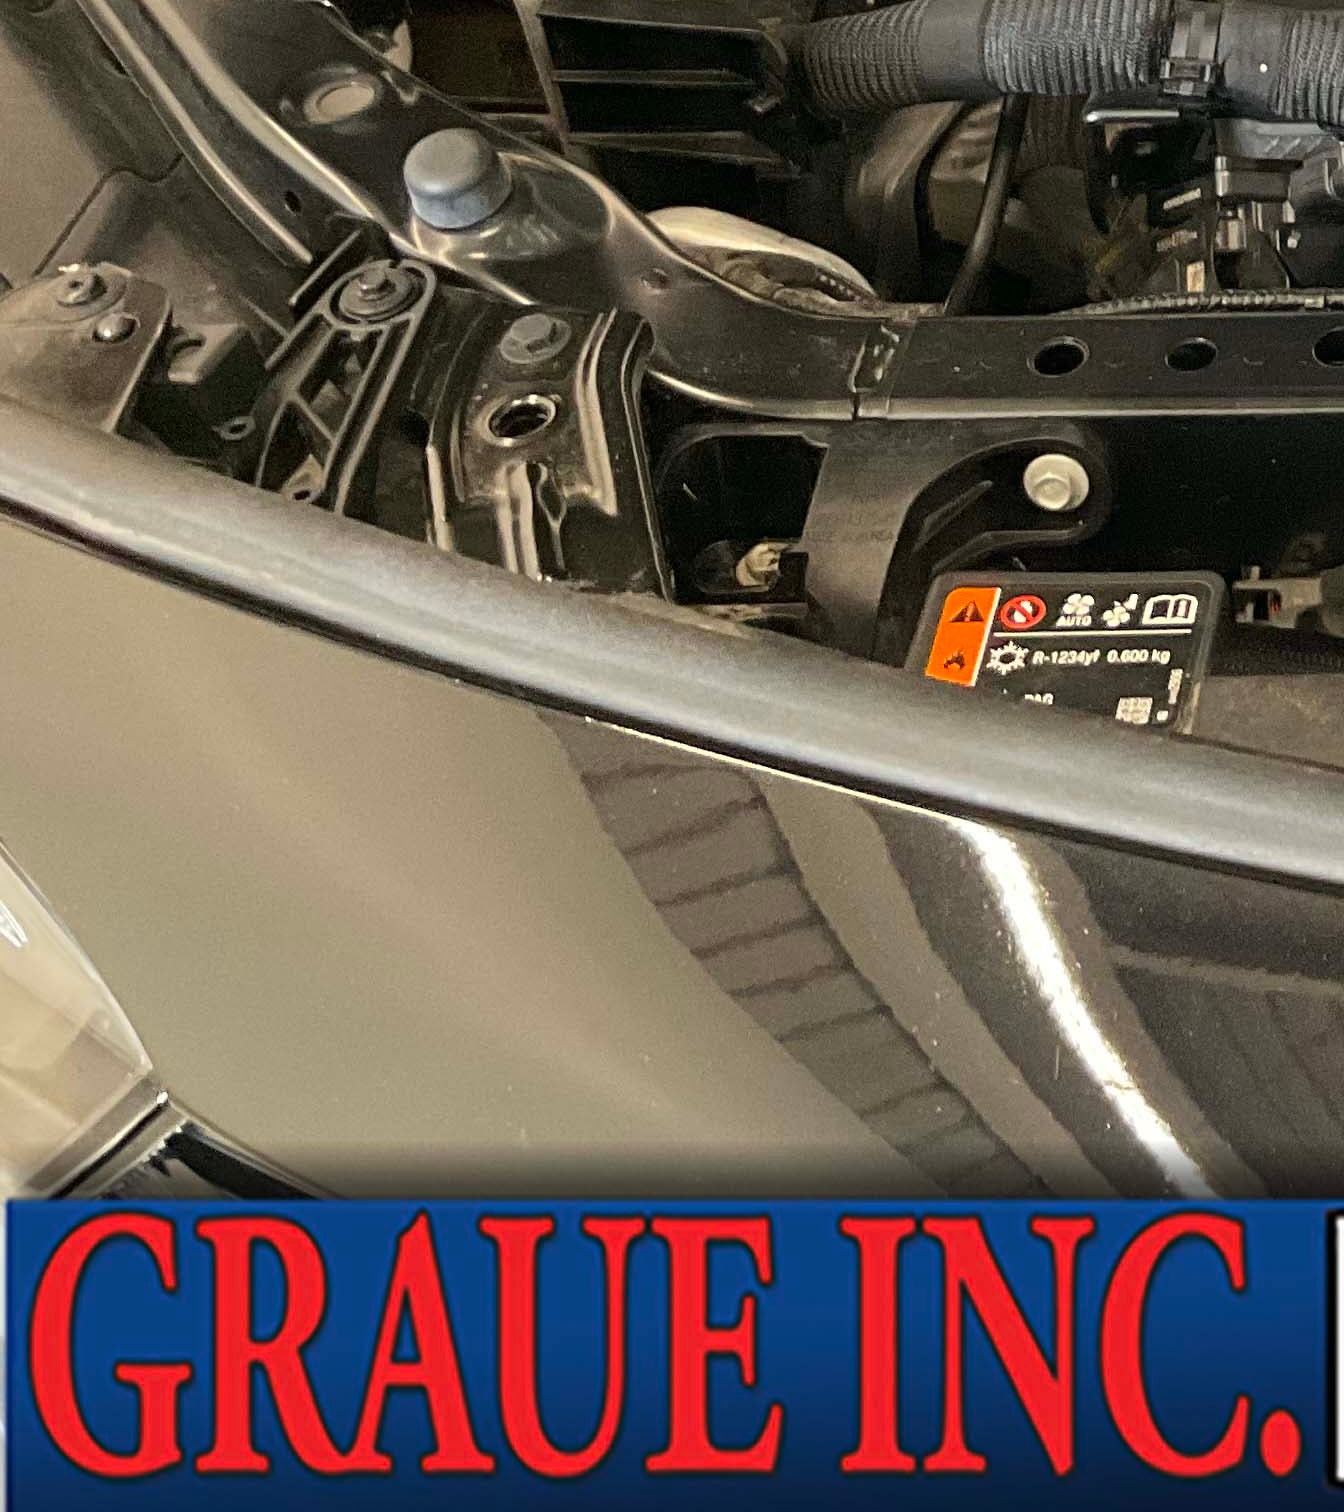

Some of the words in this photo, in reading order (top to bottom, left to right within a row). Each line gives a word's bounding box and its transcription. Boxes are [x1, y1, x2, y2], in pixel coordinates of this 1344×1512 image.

[1055, 616, 1092, 627] AUTO
[1031, 649, 1100, 666] R-1234yf
[1151, 648, 1171, 665] kg
